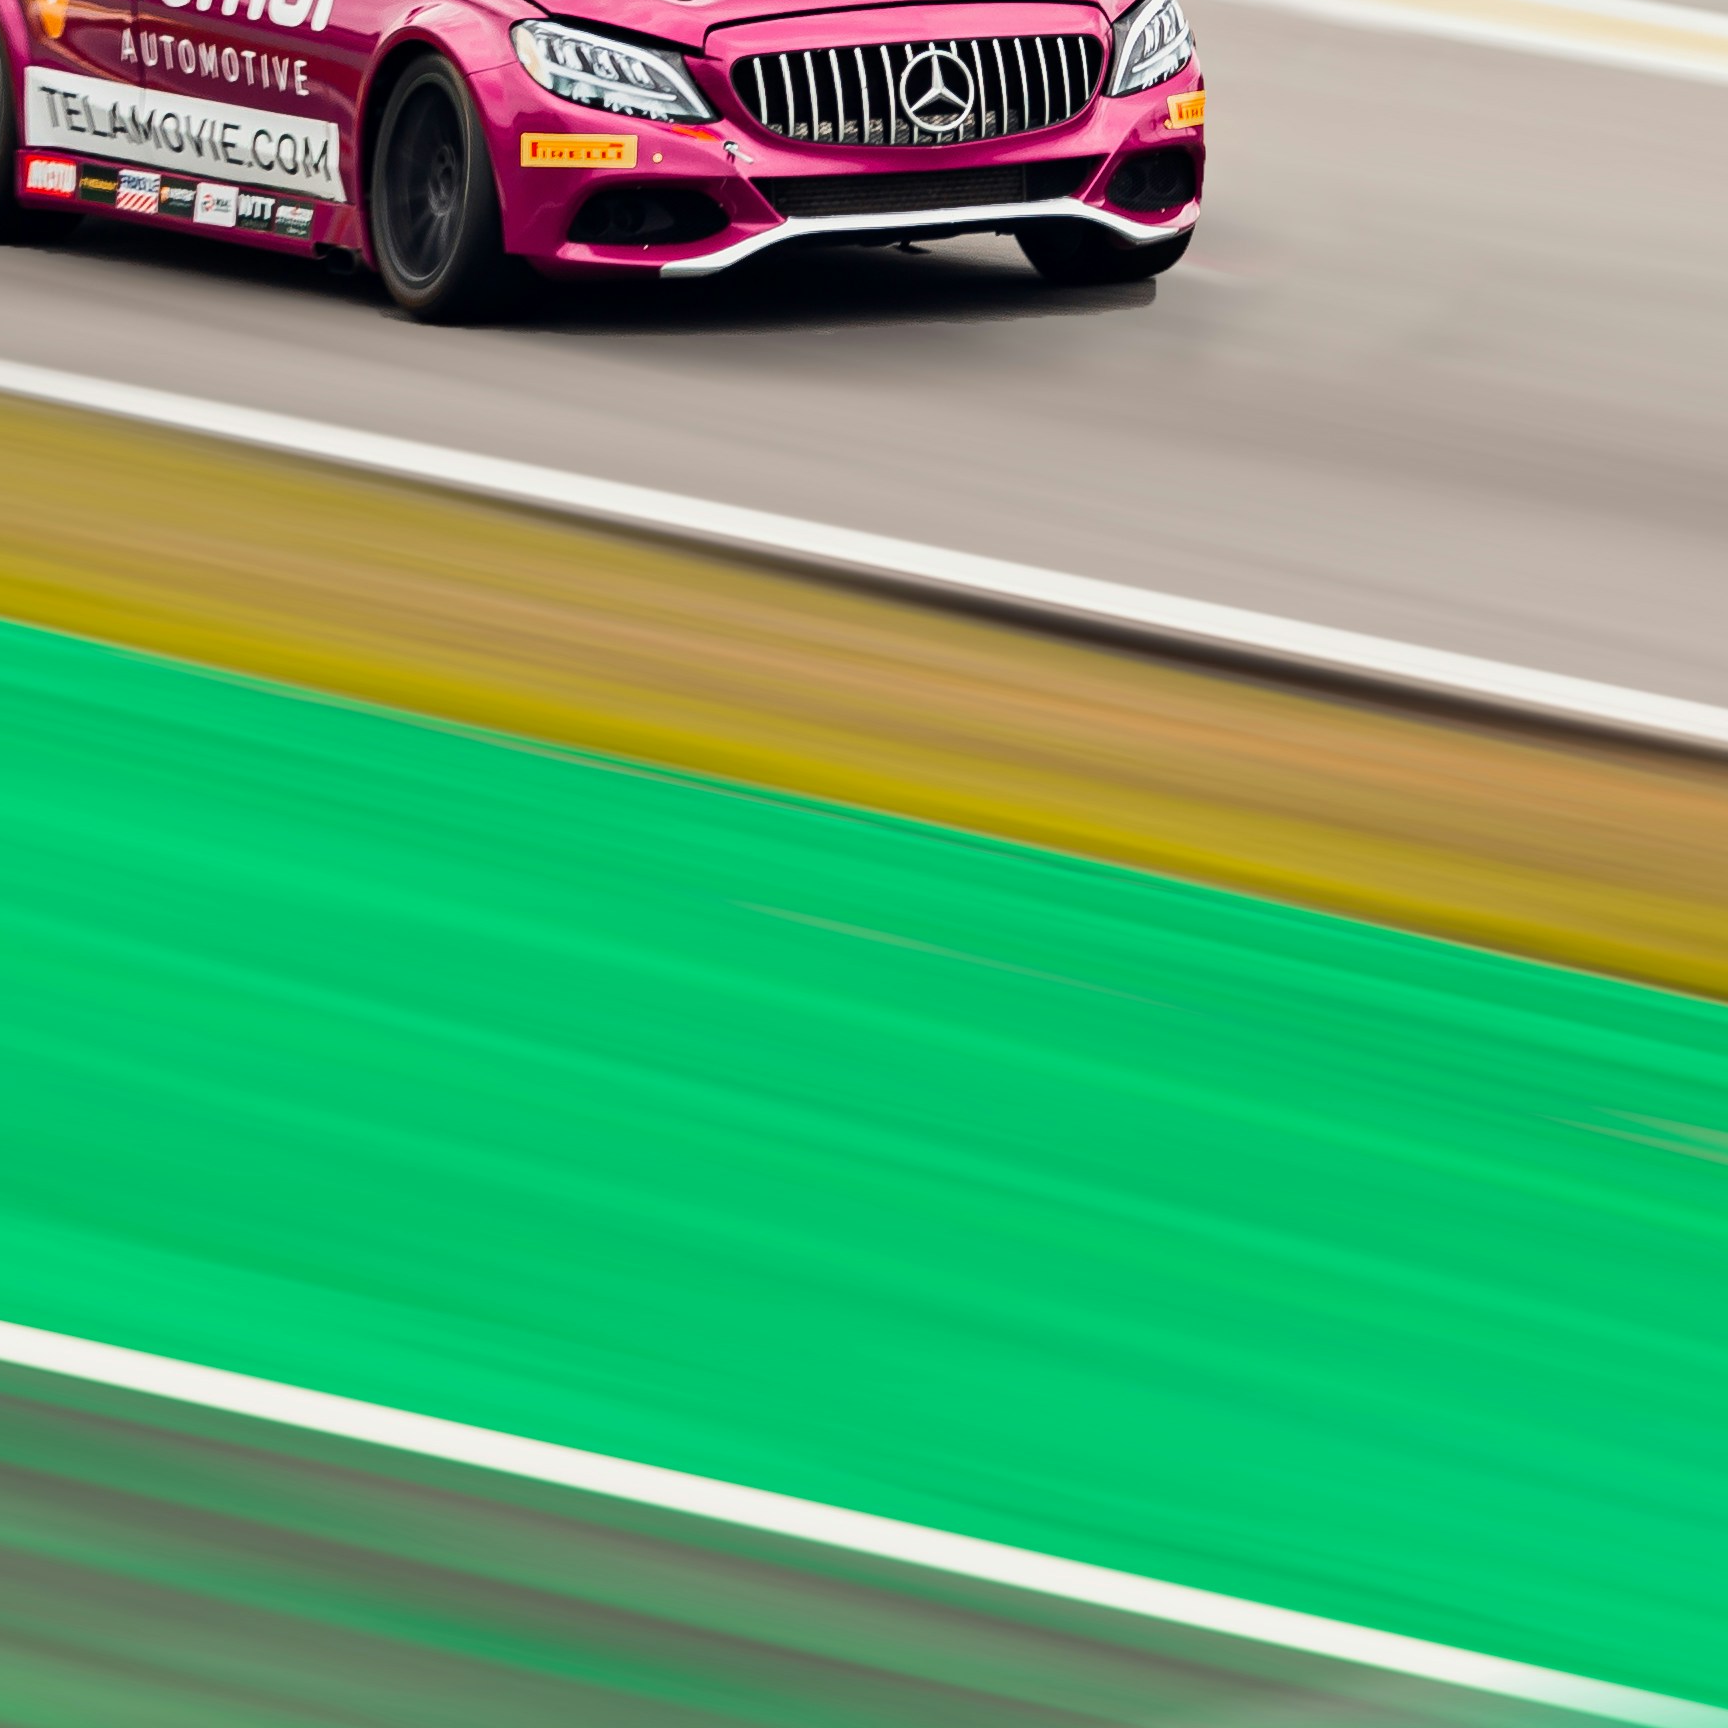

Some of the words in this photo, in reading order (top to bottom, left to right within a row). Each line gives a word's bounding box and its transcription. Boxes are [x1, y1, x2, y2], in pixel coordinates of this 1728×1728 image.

[121, 28, 310, 96] AUTOMOTIVE
[41, 85, 332, 181] TELAMOVIE.COM
[531, 140, 624, 161] PIRELLI
